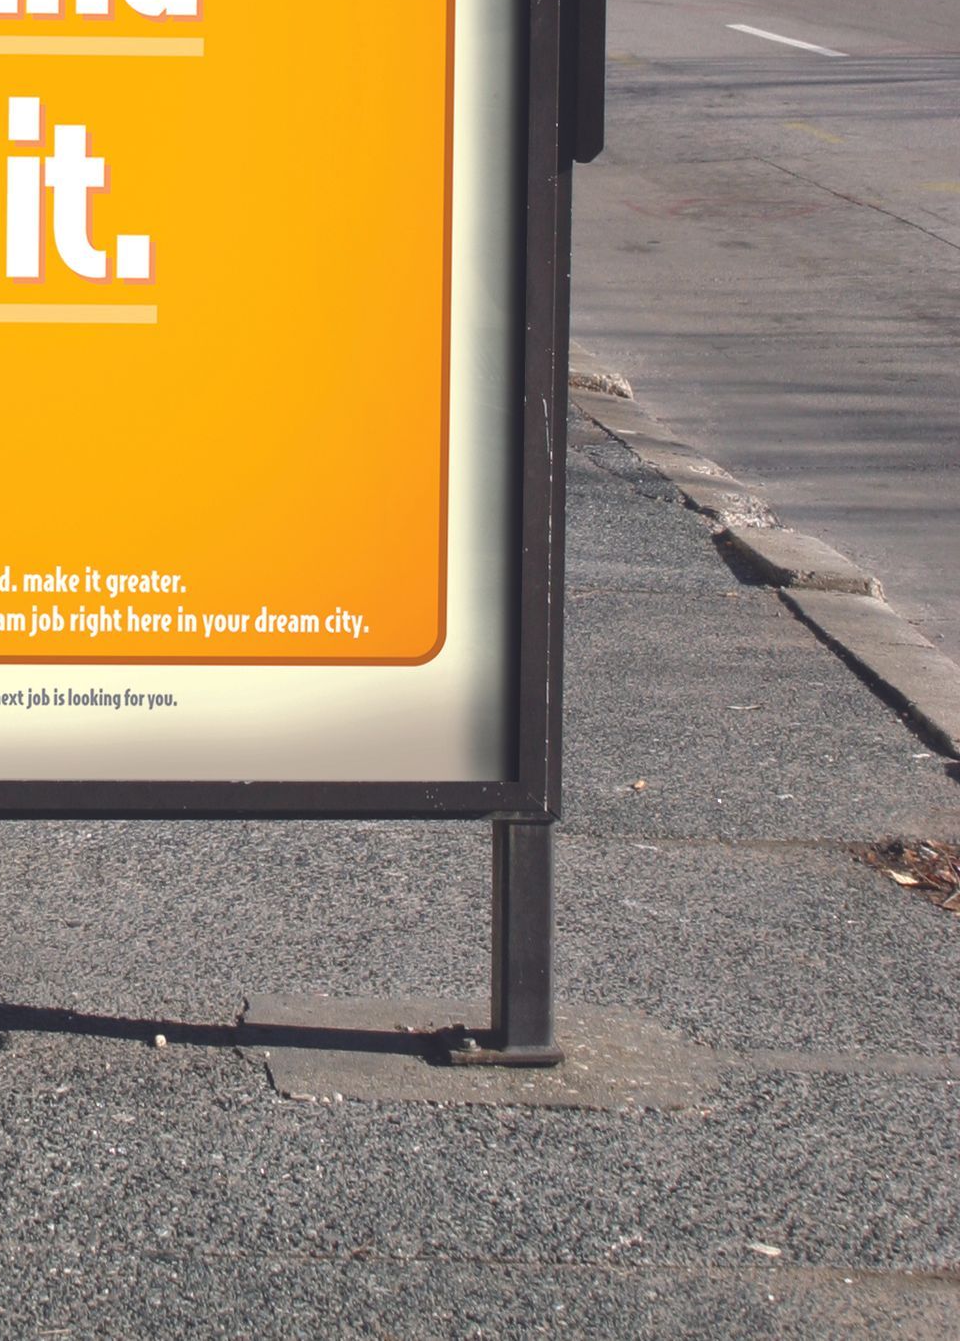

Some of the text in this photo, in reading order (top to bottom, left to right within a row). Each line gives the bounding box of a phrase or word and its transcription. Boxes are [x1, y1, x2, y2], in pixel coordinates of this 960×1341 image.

[6, 96, 152, 280] it.
[23, 565, 80, 593] make
[85, 566, 101, 593] it
[106, 569, 187, 598] greater.
[29, 605, 65, 638] job
[69, 605, 122, 638] right
[127, 606, 172, 633] here
[177, 606, 197, 633] in
[202, 613, 250, 638] your
[254, 606, 320, 634] dream
[324, 606, 369, 638] city.
[26, 688, 50, 709] job
[53, 688, 65, 706] is
[68, 688, 121, 710] looking
[124, 688, 145, 706] for
[147, 693, 178, 710] you.
